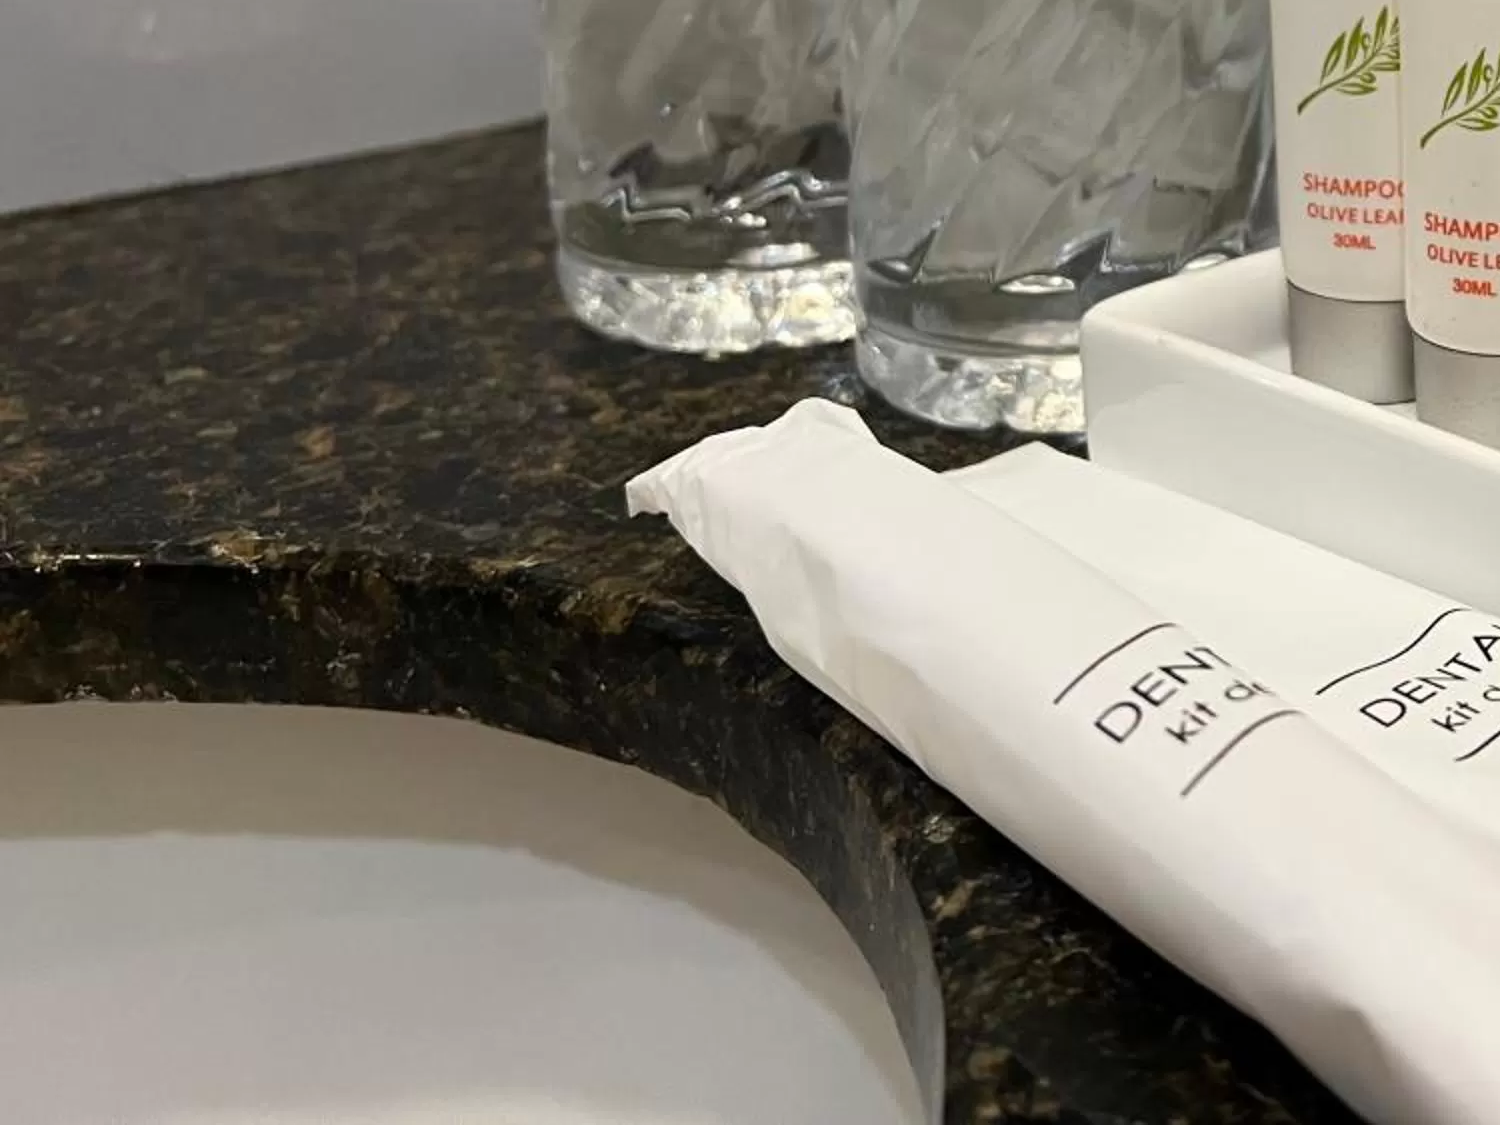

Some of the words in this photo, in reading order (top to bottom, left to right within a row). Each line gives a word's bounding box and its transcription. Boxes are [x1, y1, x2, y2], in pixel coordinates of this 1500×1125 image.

[1306, 202, 1358, 225] OLIVE
[1333, 232, 1377, 251] 30ML
[1427, 243, 1479, 269] OLIVE
[1452, 277, 1498, 297] 30ML
[1164, 700, 1220, 744] kit
[1430, 700, 1481, 734] kit
